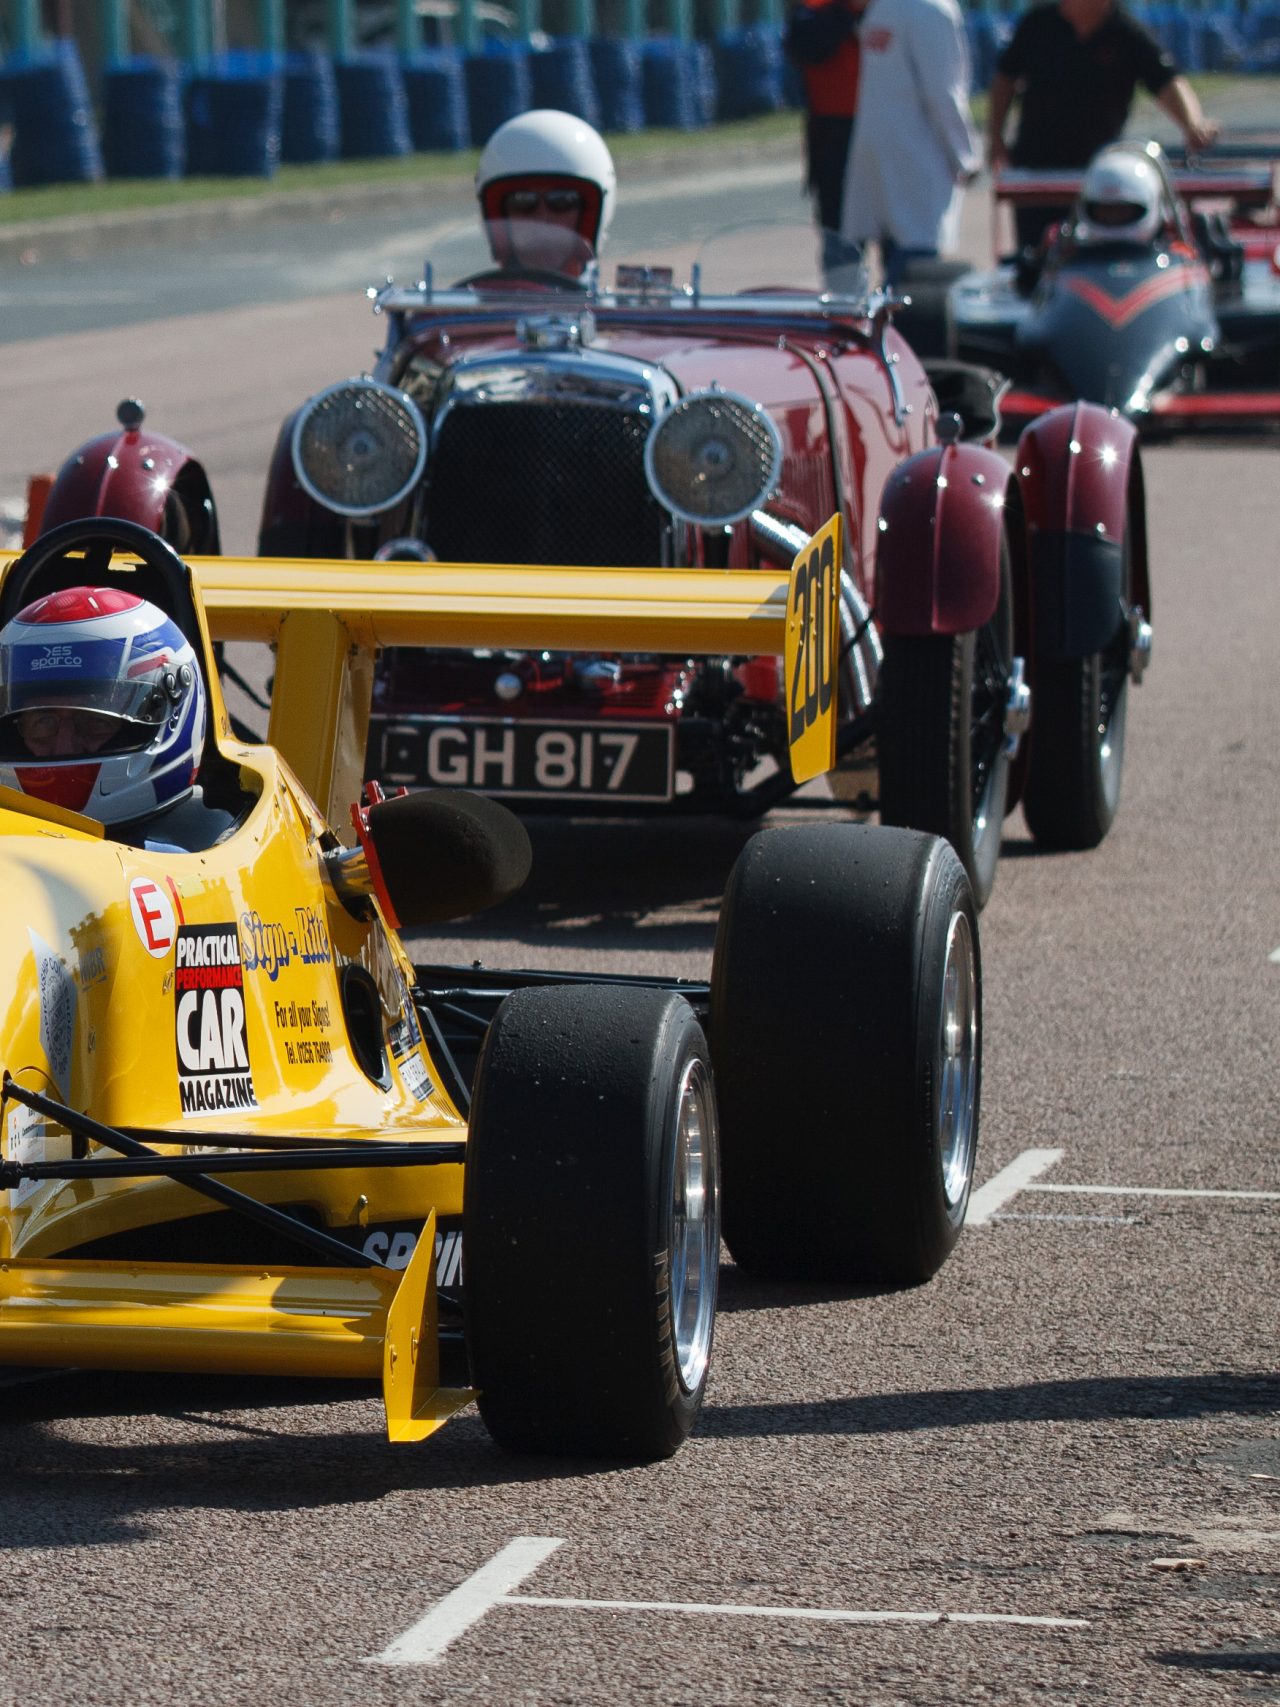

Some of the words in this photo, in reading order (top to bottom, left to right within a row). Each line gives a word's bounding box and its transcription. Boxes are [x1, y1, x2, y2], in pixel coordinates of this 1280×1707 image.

[789, 535, 836, 747] 200
[31, 656, 82, 670] sparco
[534, 731, 639, 790] 817
[132, 884, 170, 950] E
[176, 934, 240, 968] PRACTICAL
[175, 965, 243, 991] PERFORMANCE
[177, 988, 250, 1071] CAR
[274, 1000, 288, 1028] For
[288, 1001, 299, 1027] all
[298, 1005, 313, 1033] your
[178, 1076, 259, 1113] MAGAZINE
